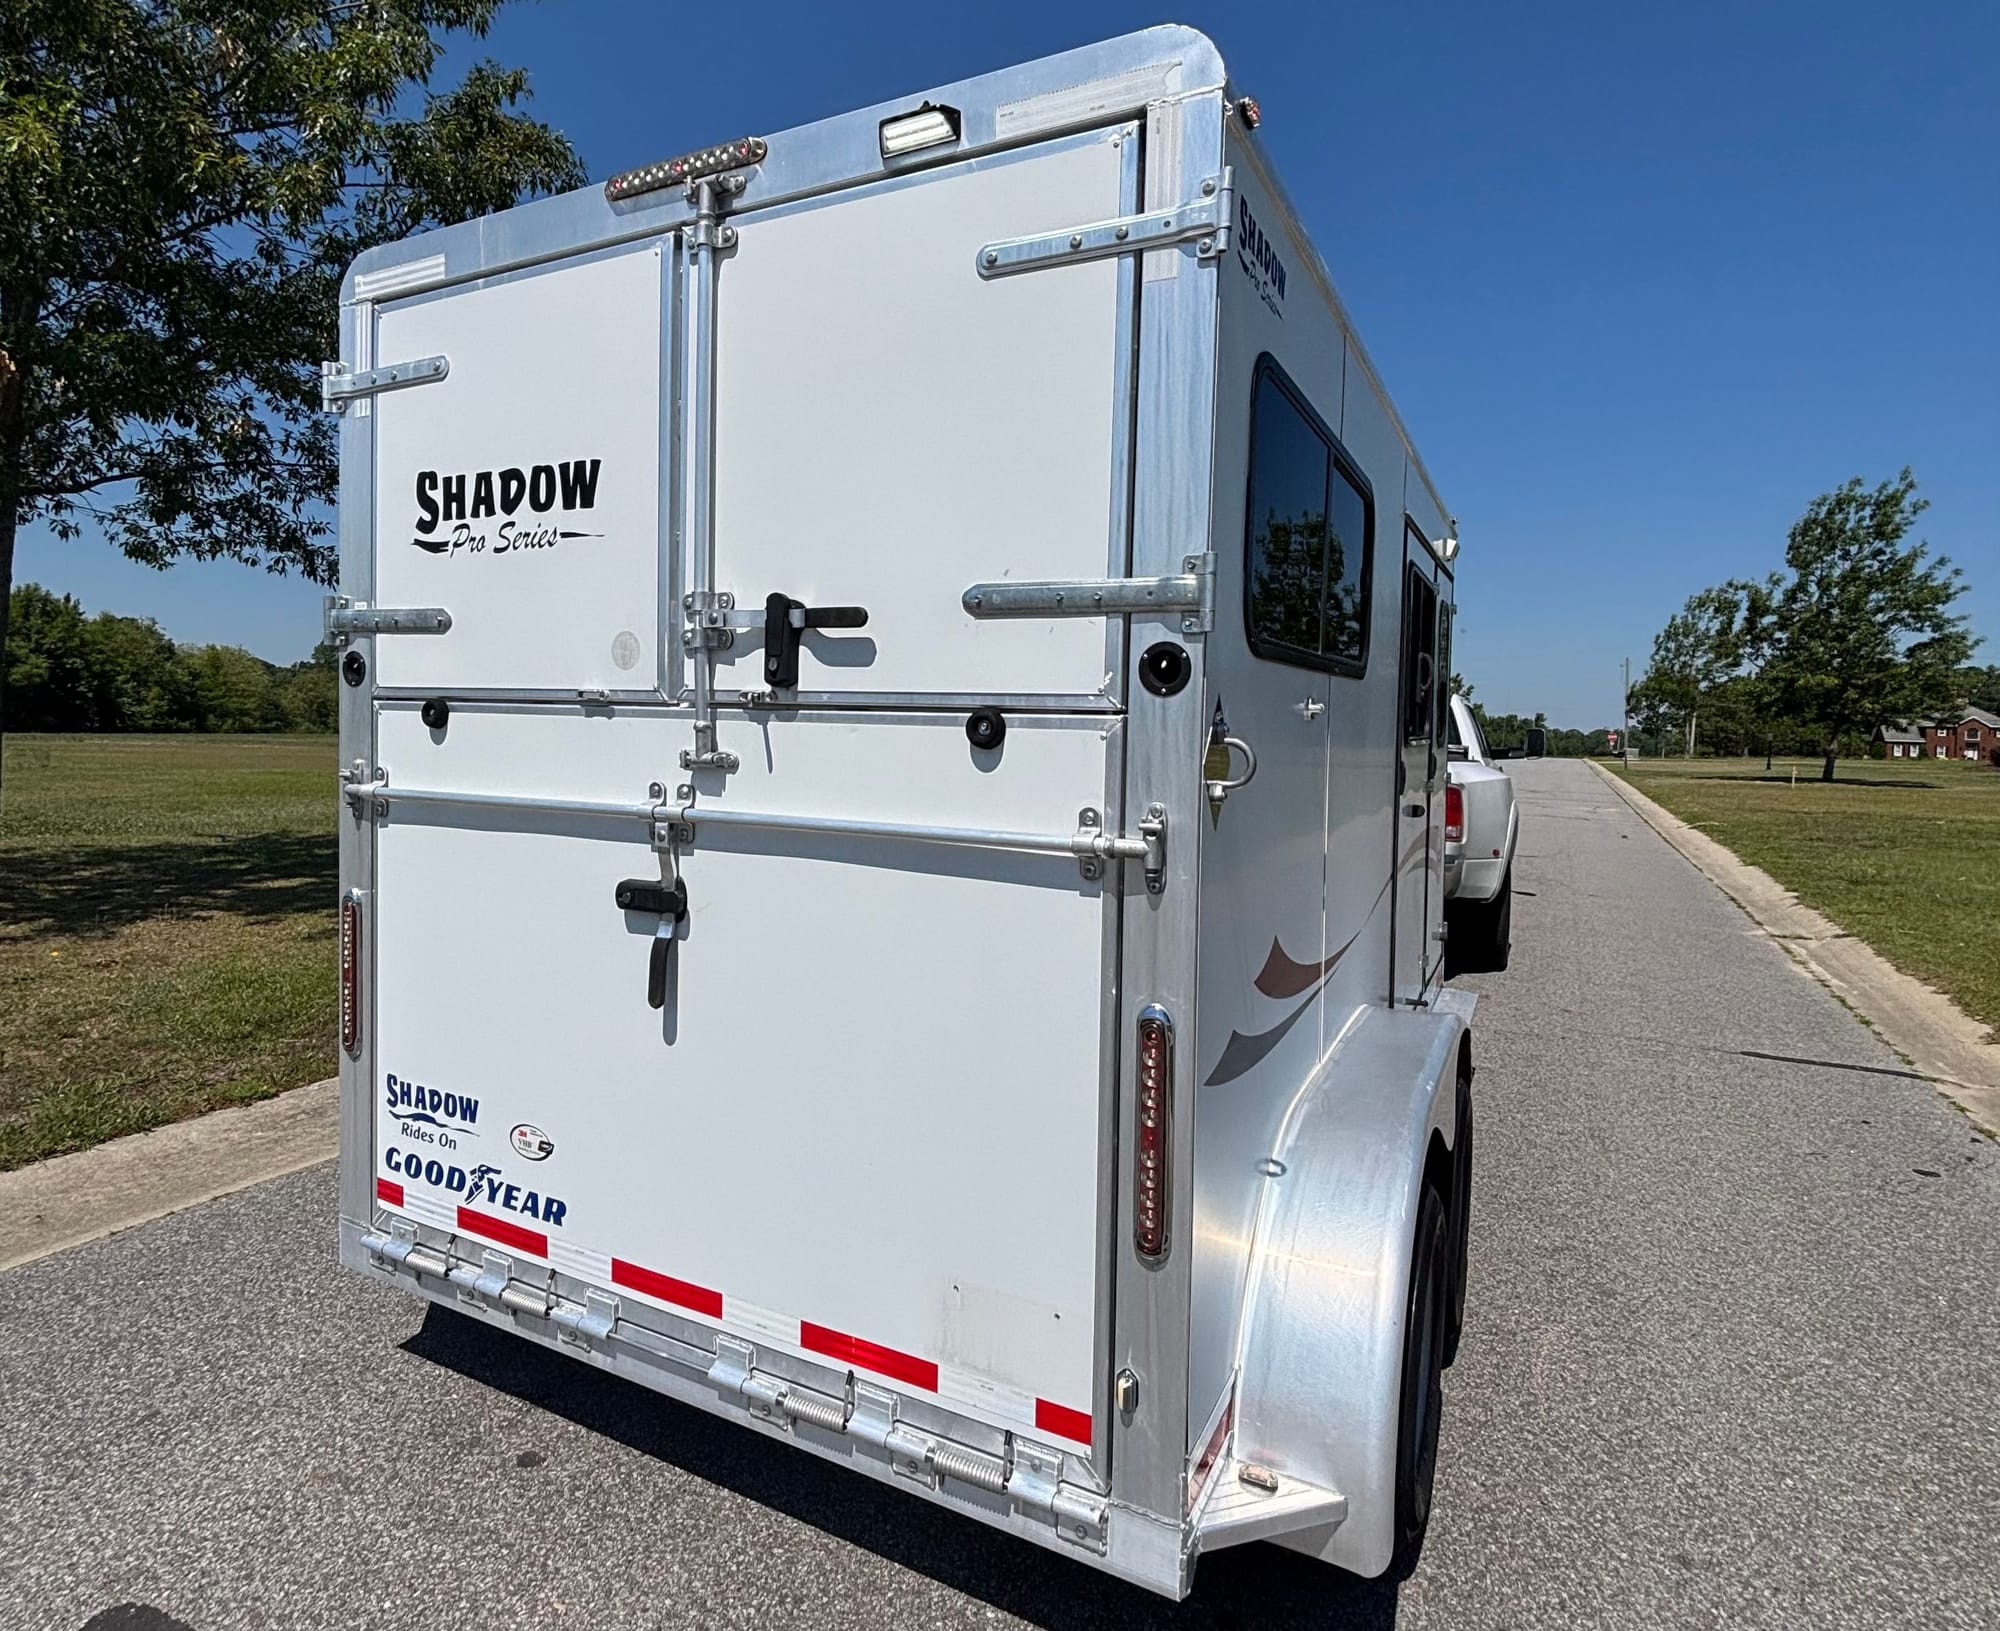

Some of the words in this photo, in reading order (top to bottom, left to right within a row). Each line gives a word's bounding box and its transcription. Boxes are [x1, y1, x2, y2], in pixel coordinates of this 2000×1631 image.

[1239, 194, 1286, 300] SHADOW
[415, 459, 602, 535] SHADOW
[450, 523, 486, 558] Pro
[493, 521, 559, 553] Series
[386, 1073, 480, 1124] SHADOW
[401, 1122, 434, 1144] Rides
[438, 1133, 457, 1150] On
